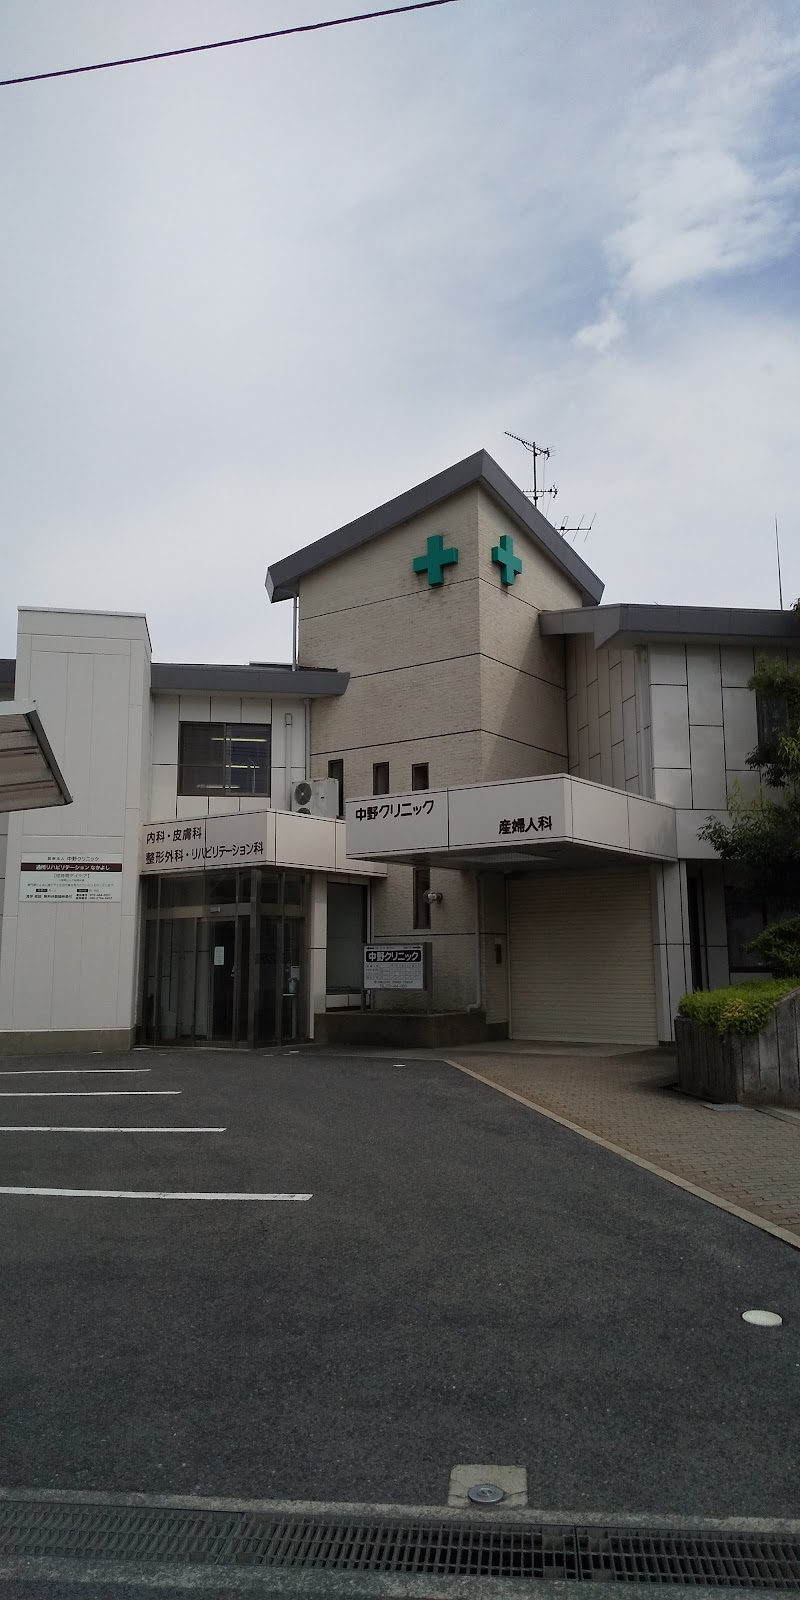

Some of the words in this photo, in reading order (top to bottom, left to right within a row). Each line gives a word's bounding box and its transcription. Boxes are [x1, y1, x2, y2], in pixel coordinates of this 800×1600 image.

[355, 800, 435, 821] 中野クリニック
[146, 826, 202, 844] 内科・皮膚科
[498, 816, 553, 835] 産婦人科
[145, 841, 264, 865] 整形外科・リハビリテーション科
[368, 951, 419, 962] 中野クリニック
